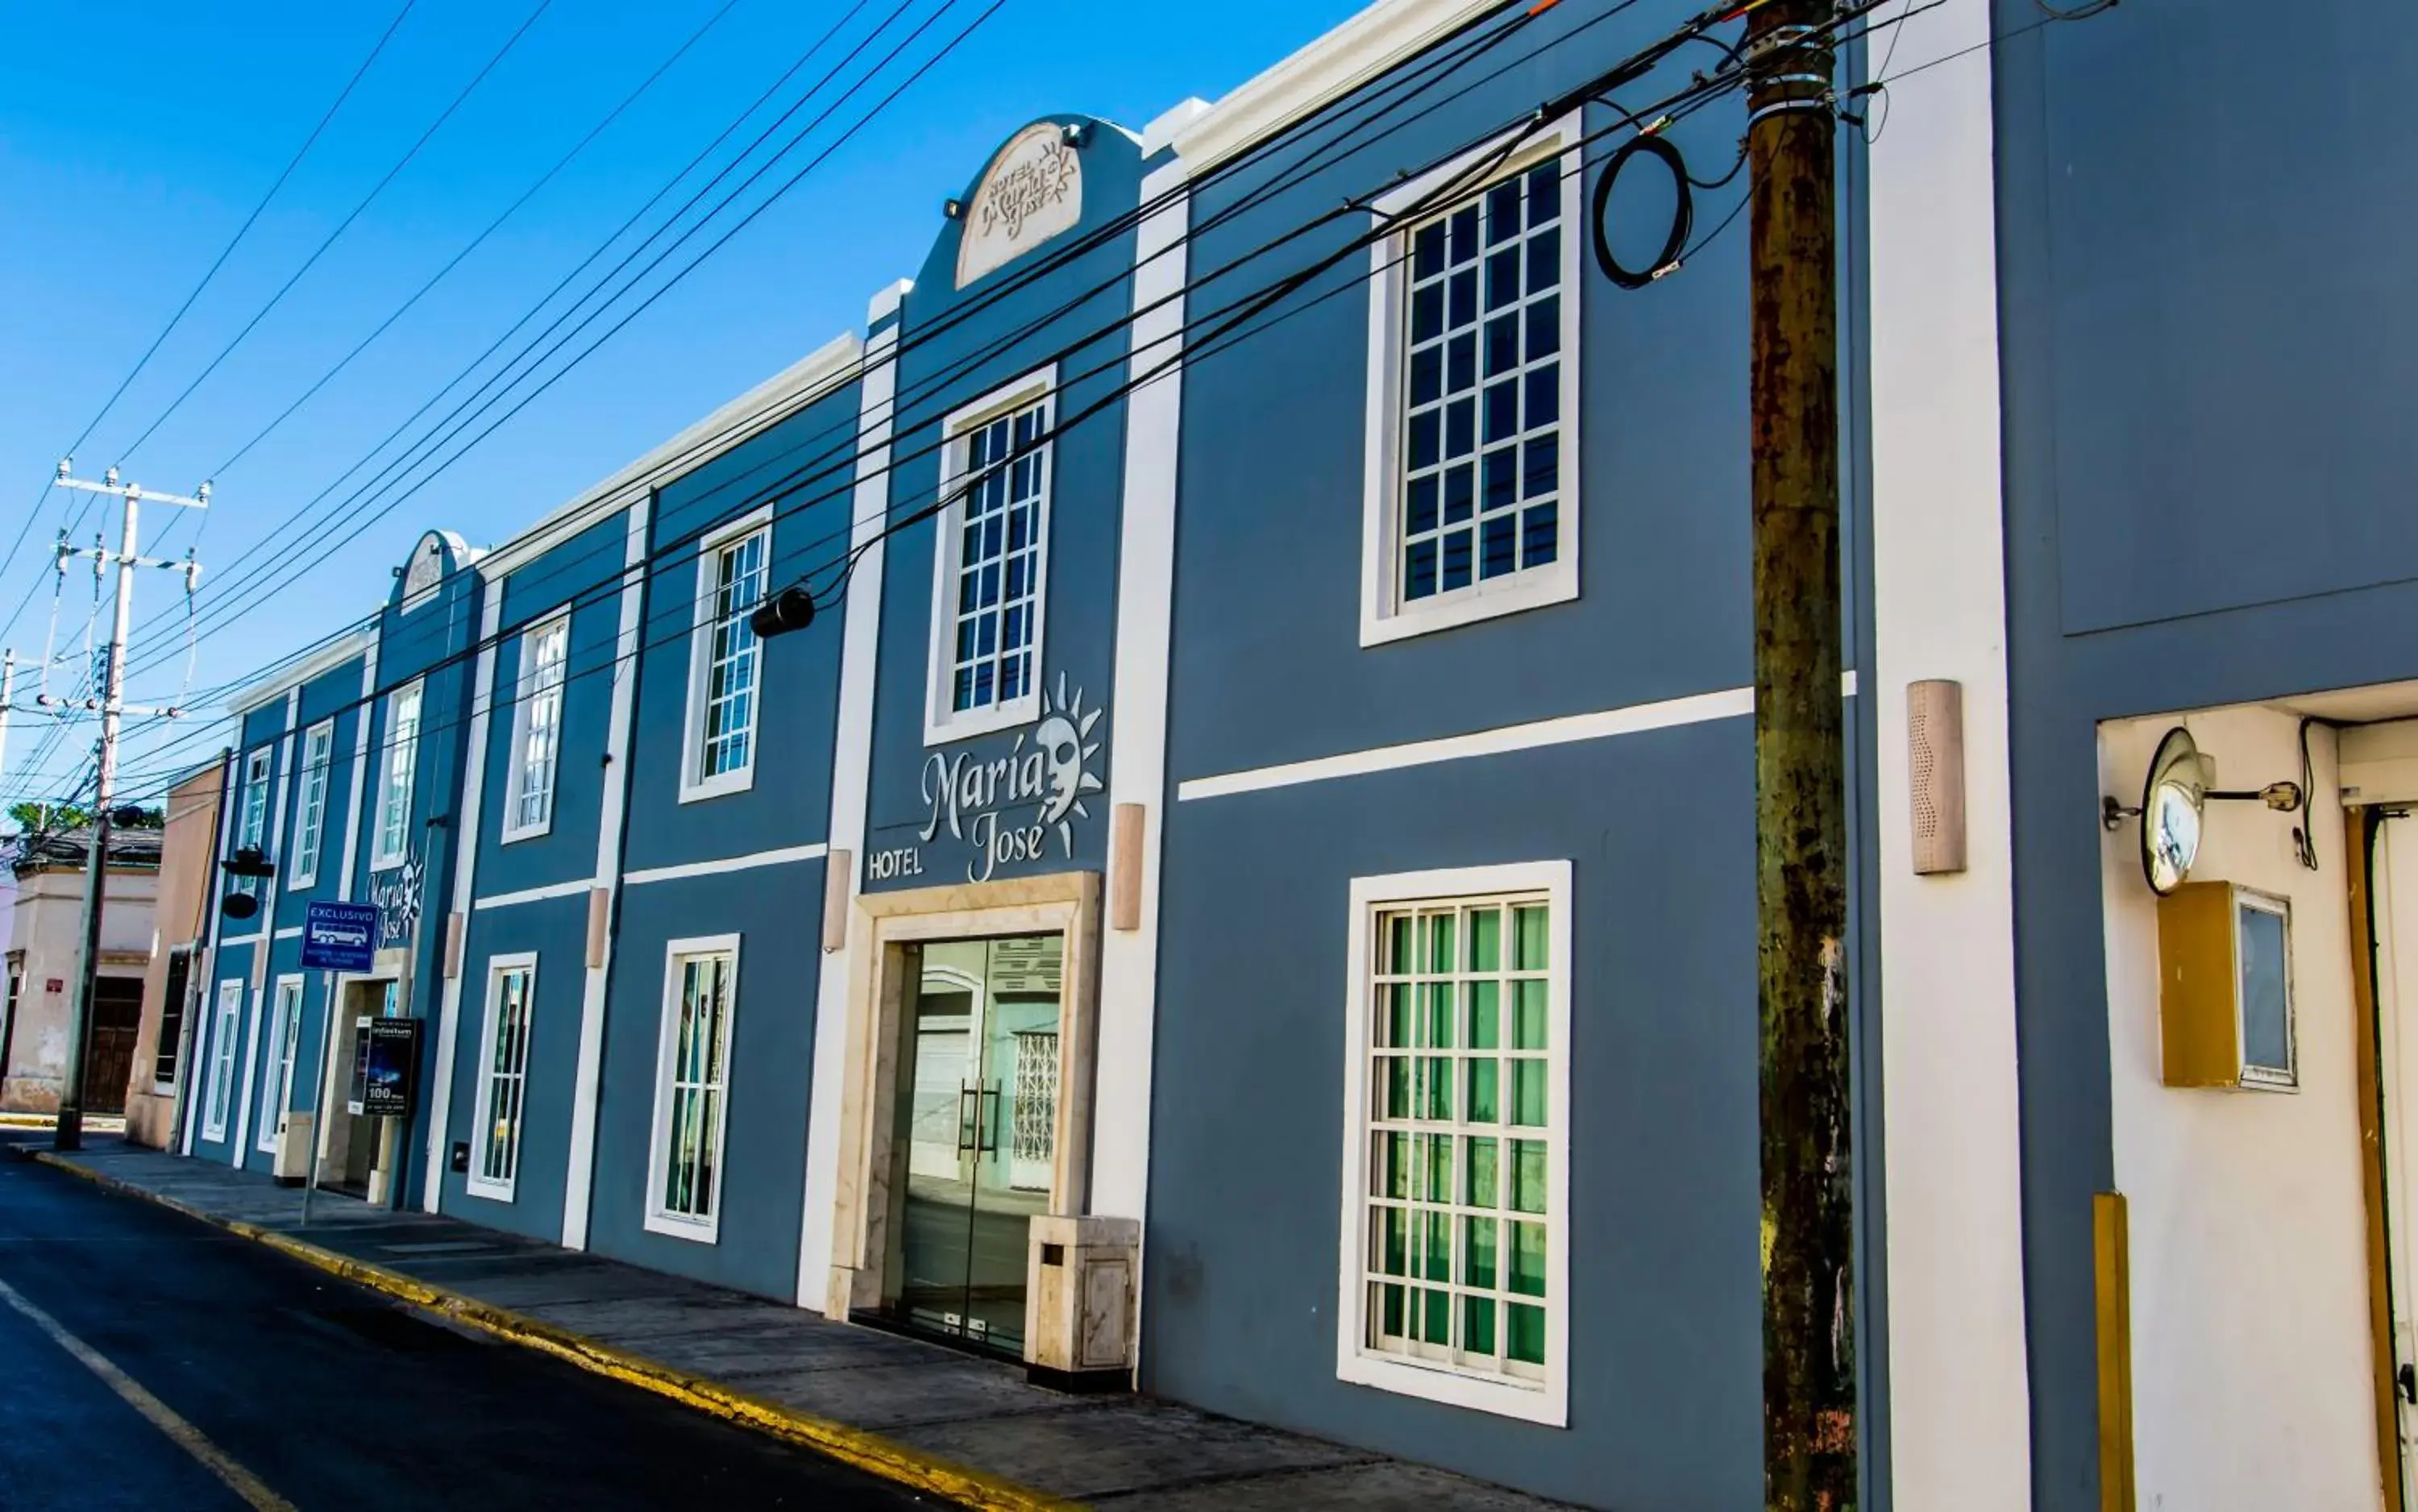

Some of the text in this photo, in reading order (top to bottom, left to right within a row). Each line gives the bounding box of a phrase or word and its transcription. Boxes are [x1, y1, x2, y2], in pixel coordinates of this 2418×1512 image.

[919, 733, 1045, 841] María
[967, 806, 1047, 884] José
[870, 847, 923, 880] HOTEL
[310, 907, 373, 922] EXCLUSIVO
[369, 1087, 391, 1099] 100
